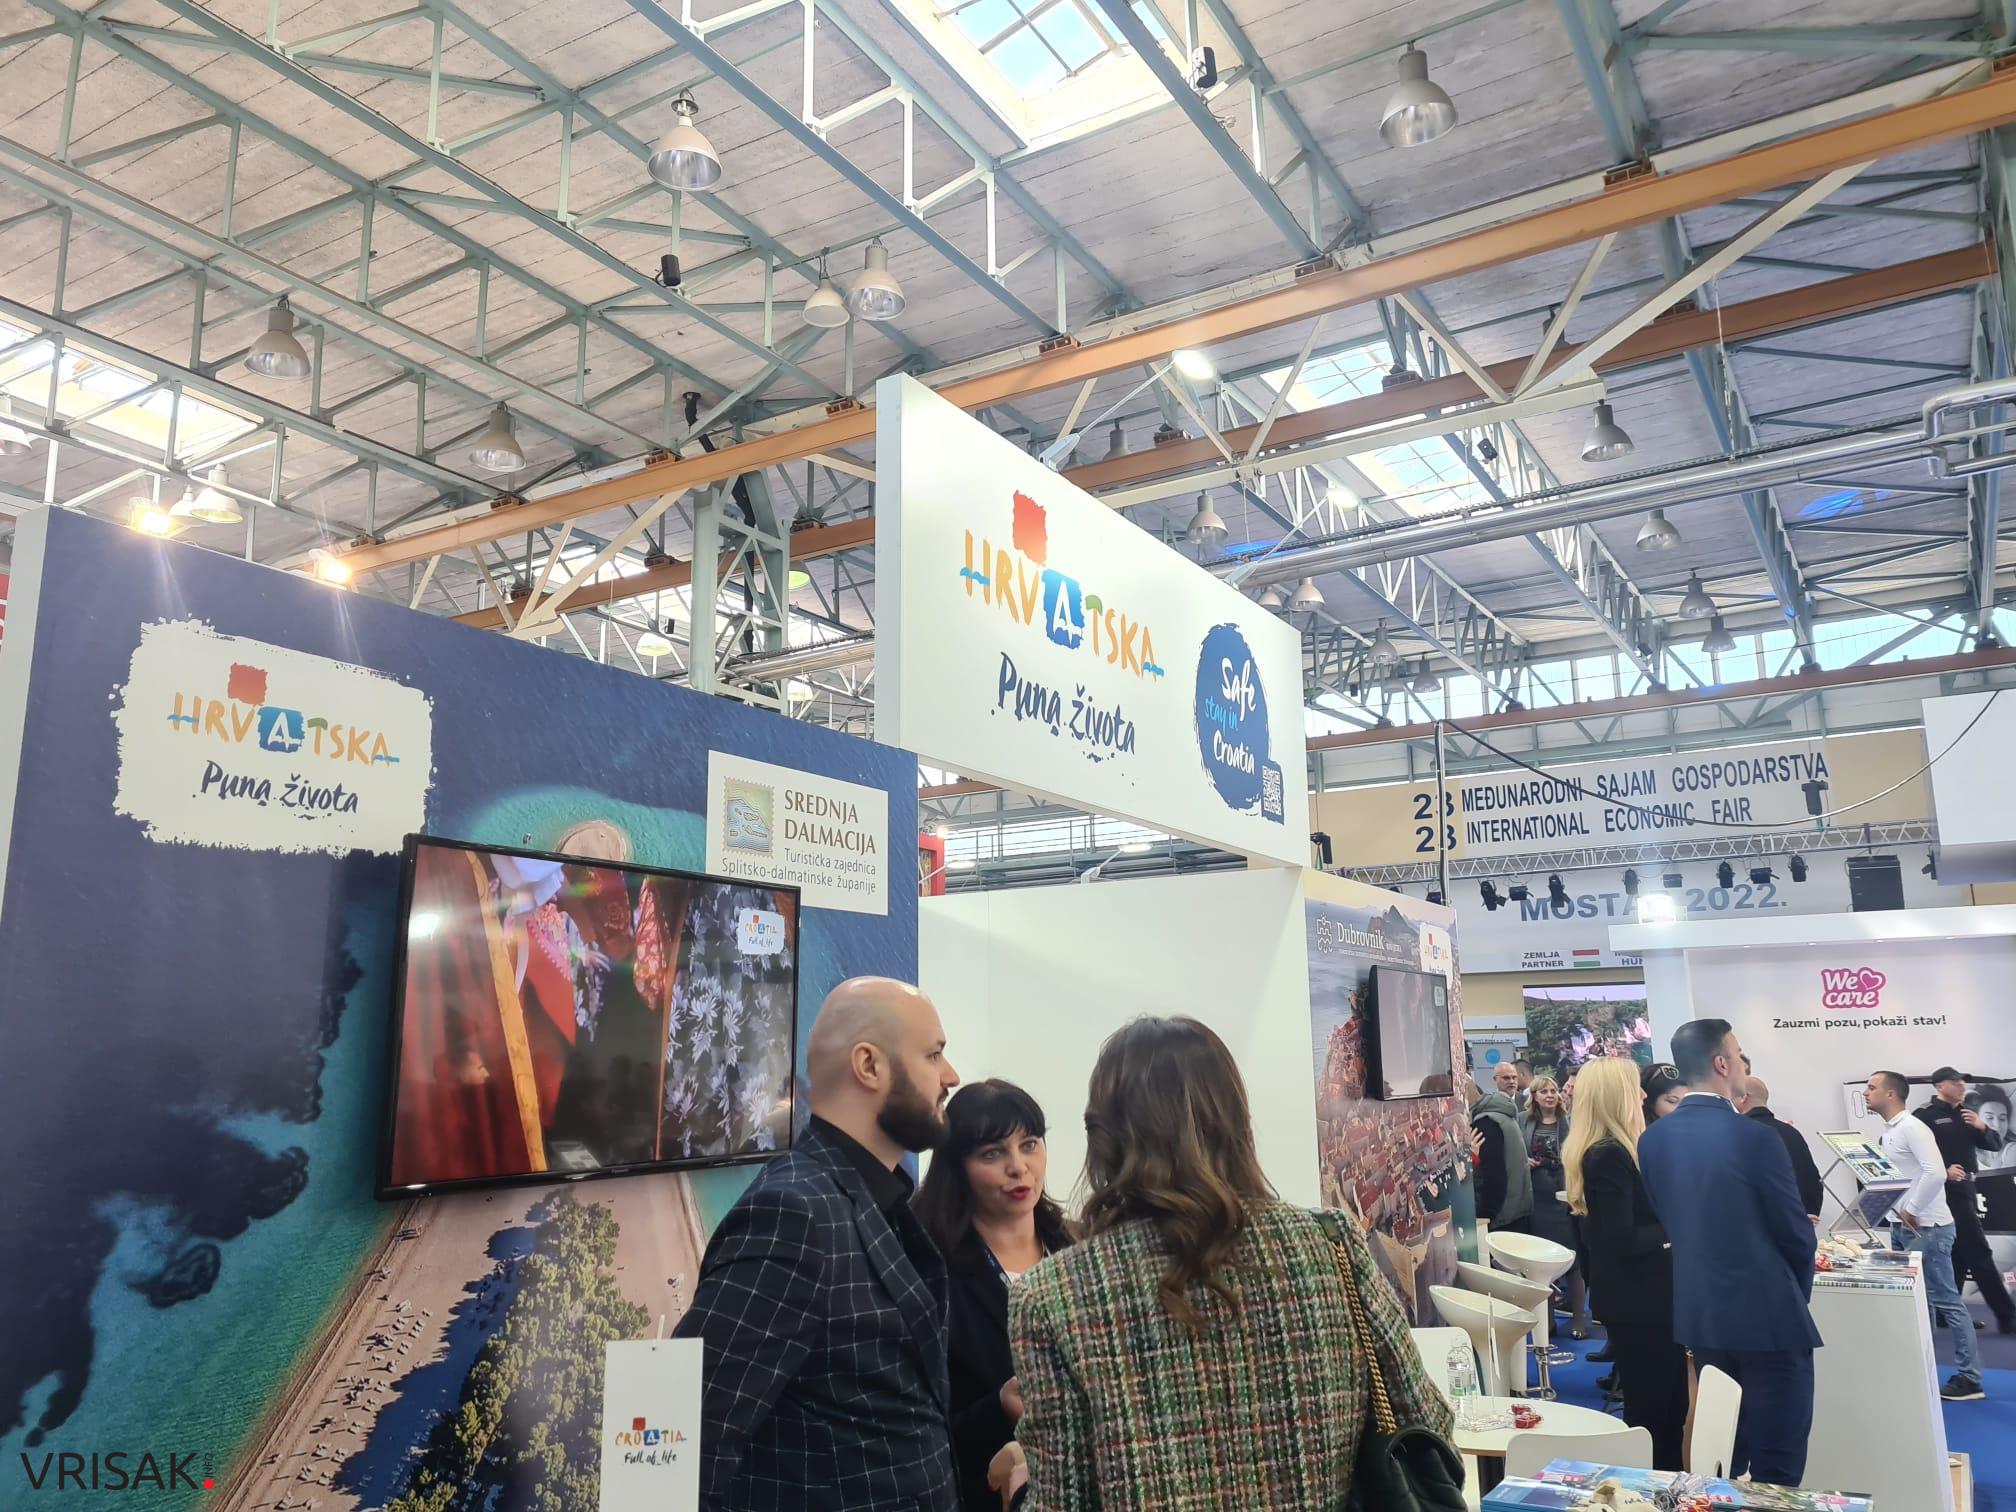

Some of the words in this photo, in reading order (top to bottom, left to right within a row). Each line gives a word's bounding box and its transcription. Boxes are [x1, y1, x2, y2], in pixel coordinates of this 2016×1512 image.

[960, 529, 1164, 681] HRVATSKA
[998, 652, 1061, 734] Puna
[1071, 683, 1135, 755] života
[1221, 657, 1256, 721] Safe
[167, 691, 400, 767] HRVATSKA
[1205, 696, 1226, 735] stay
[1229, 707, 1239, 730] in
[1213, 729, 1255, 775] Croatia
[200, 759, 272, 806] Puna
[279, 773, 359, 813] života
[1462, 777, 1583, 812] MEĐUNARODNI
[1597, 769, 1657, 799] SAJAM
[1672, 752, 1829, 792] GOSPODARSTVA
[784, 789, 858, 824] SREDNJA
[1467, 812, 1590, 844] INTERNATIONAL
[1604, 802, 1695, 832] ECONOMIC
[1712, 797, 1752, 823] FAIR
[784, 818, 876, 856] DALMACIJA
[722, 857, 833, 887] Splitsko-dalmatinske
[837, 875, 876, 895] županije
[784, 847, 831, 868] Turistička
[834, 858, 876, 875] zajednica
[1685, 883, 1788, 912] 2022.
[1336, 922, 1384, 949] Dubrovnik
[1522, 960, 1564, 969] PARTNER
[1524, 951, 1560, 959] ZEMLJA
[1823, 971, 1858, 990] We
[1825, 990, 1877, 1006] care
[1773, 1018, 1820, 1029] Zauzmi
[1825, 1018, 1860, 1030] pozu,
[1863, 1015, 1907, 1030] pokaži
[1913, 1015, 1946, 1026] stav!
[615, 1429, 687, 1446] CROATIA
[624, 1450, 644, 1464] Full
